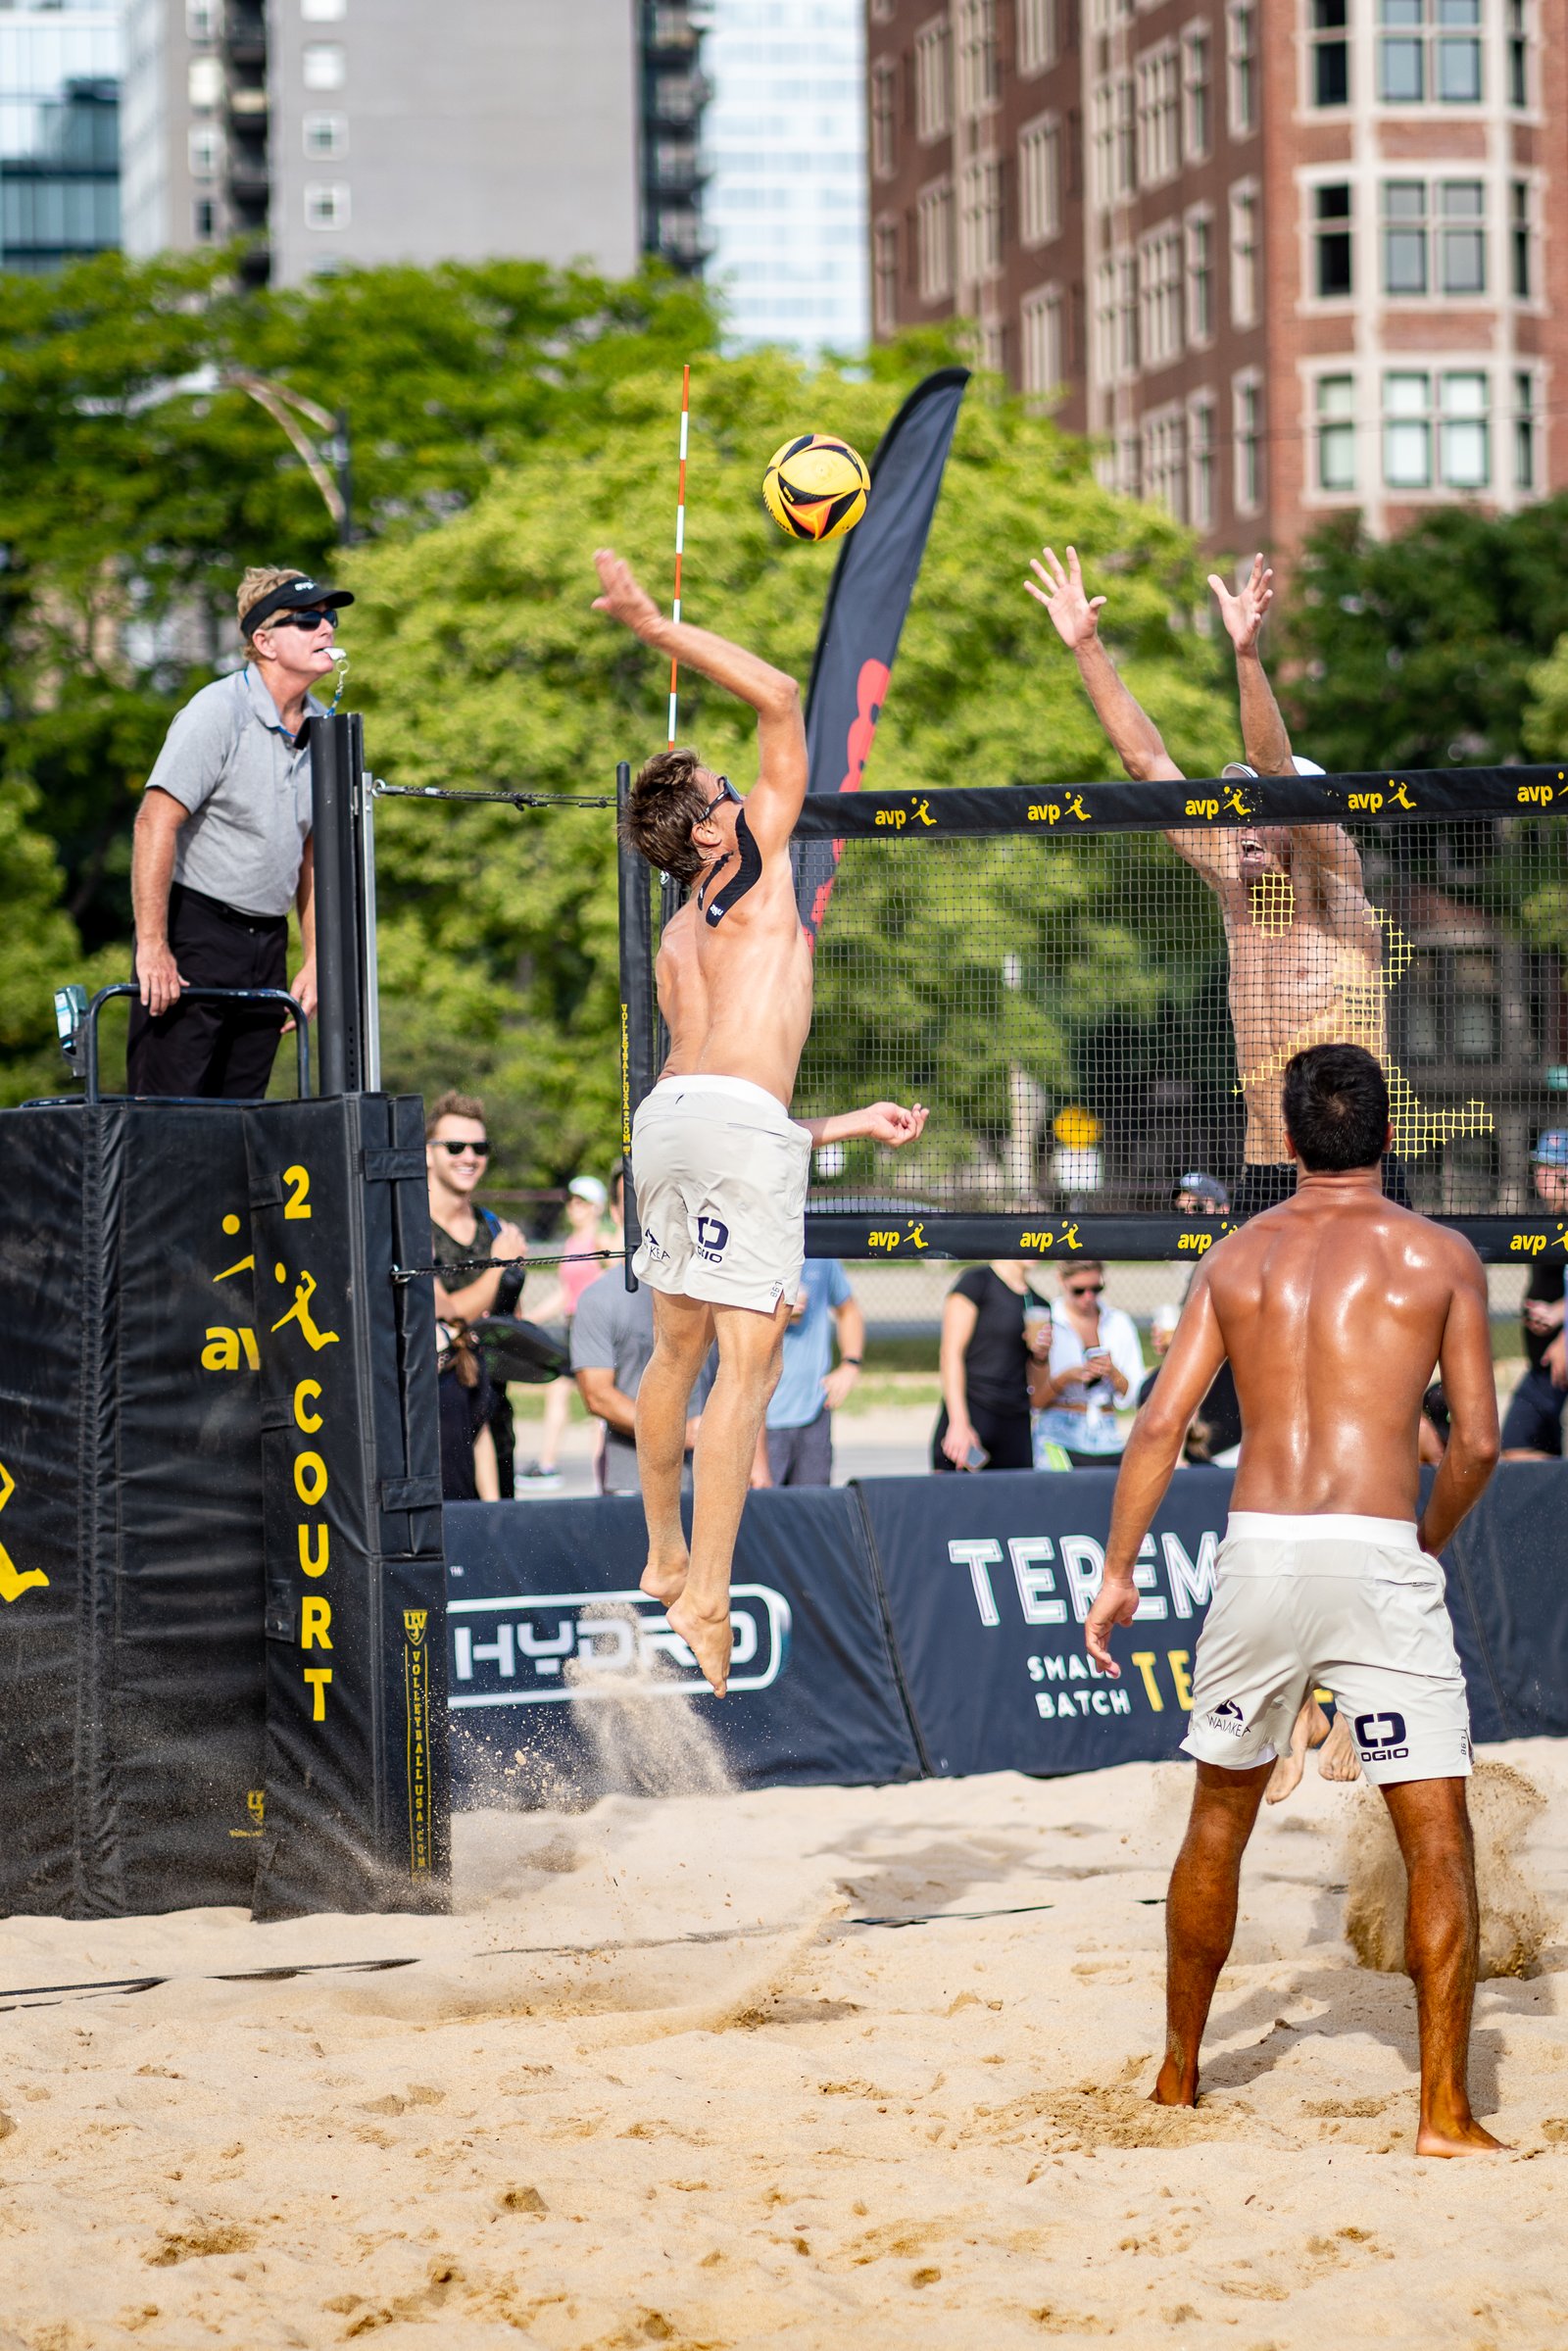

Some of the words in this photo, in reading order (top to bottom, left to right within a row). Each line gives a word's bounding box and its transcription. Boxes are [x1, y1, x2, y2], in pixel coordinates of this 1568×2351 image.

[1348, 793, 1384, 813] avp
[1517, 785, 1553, 807] avp
[874, 809, 906, 830] avp
[1027, 805, 1060, 825] avp
[1185, 799, 1219, 820] avp
[282, 1165, 312, 1220] 2
[867, 1231, 901, 1251] avp
[1019, 1232, 1054, 1252] avp
[1177, 1233, 1213, 1254] avp
[1509, 1233, 1547, 1255] avp
[201, 1326, 261, 1371] av
[293, 1379, 333, 1722] COURT
[948, 1531, 1220, 1627] TEREM
[1034, 1688, 1132, 1719] BATCH
[1360, 1747, 1409, 1763] OGIO
